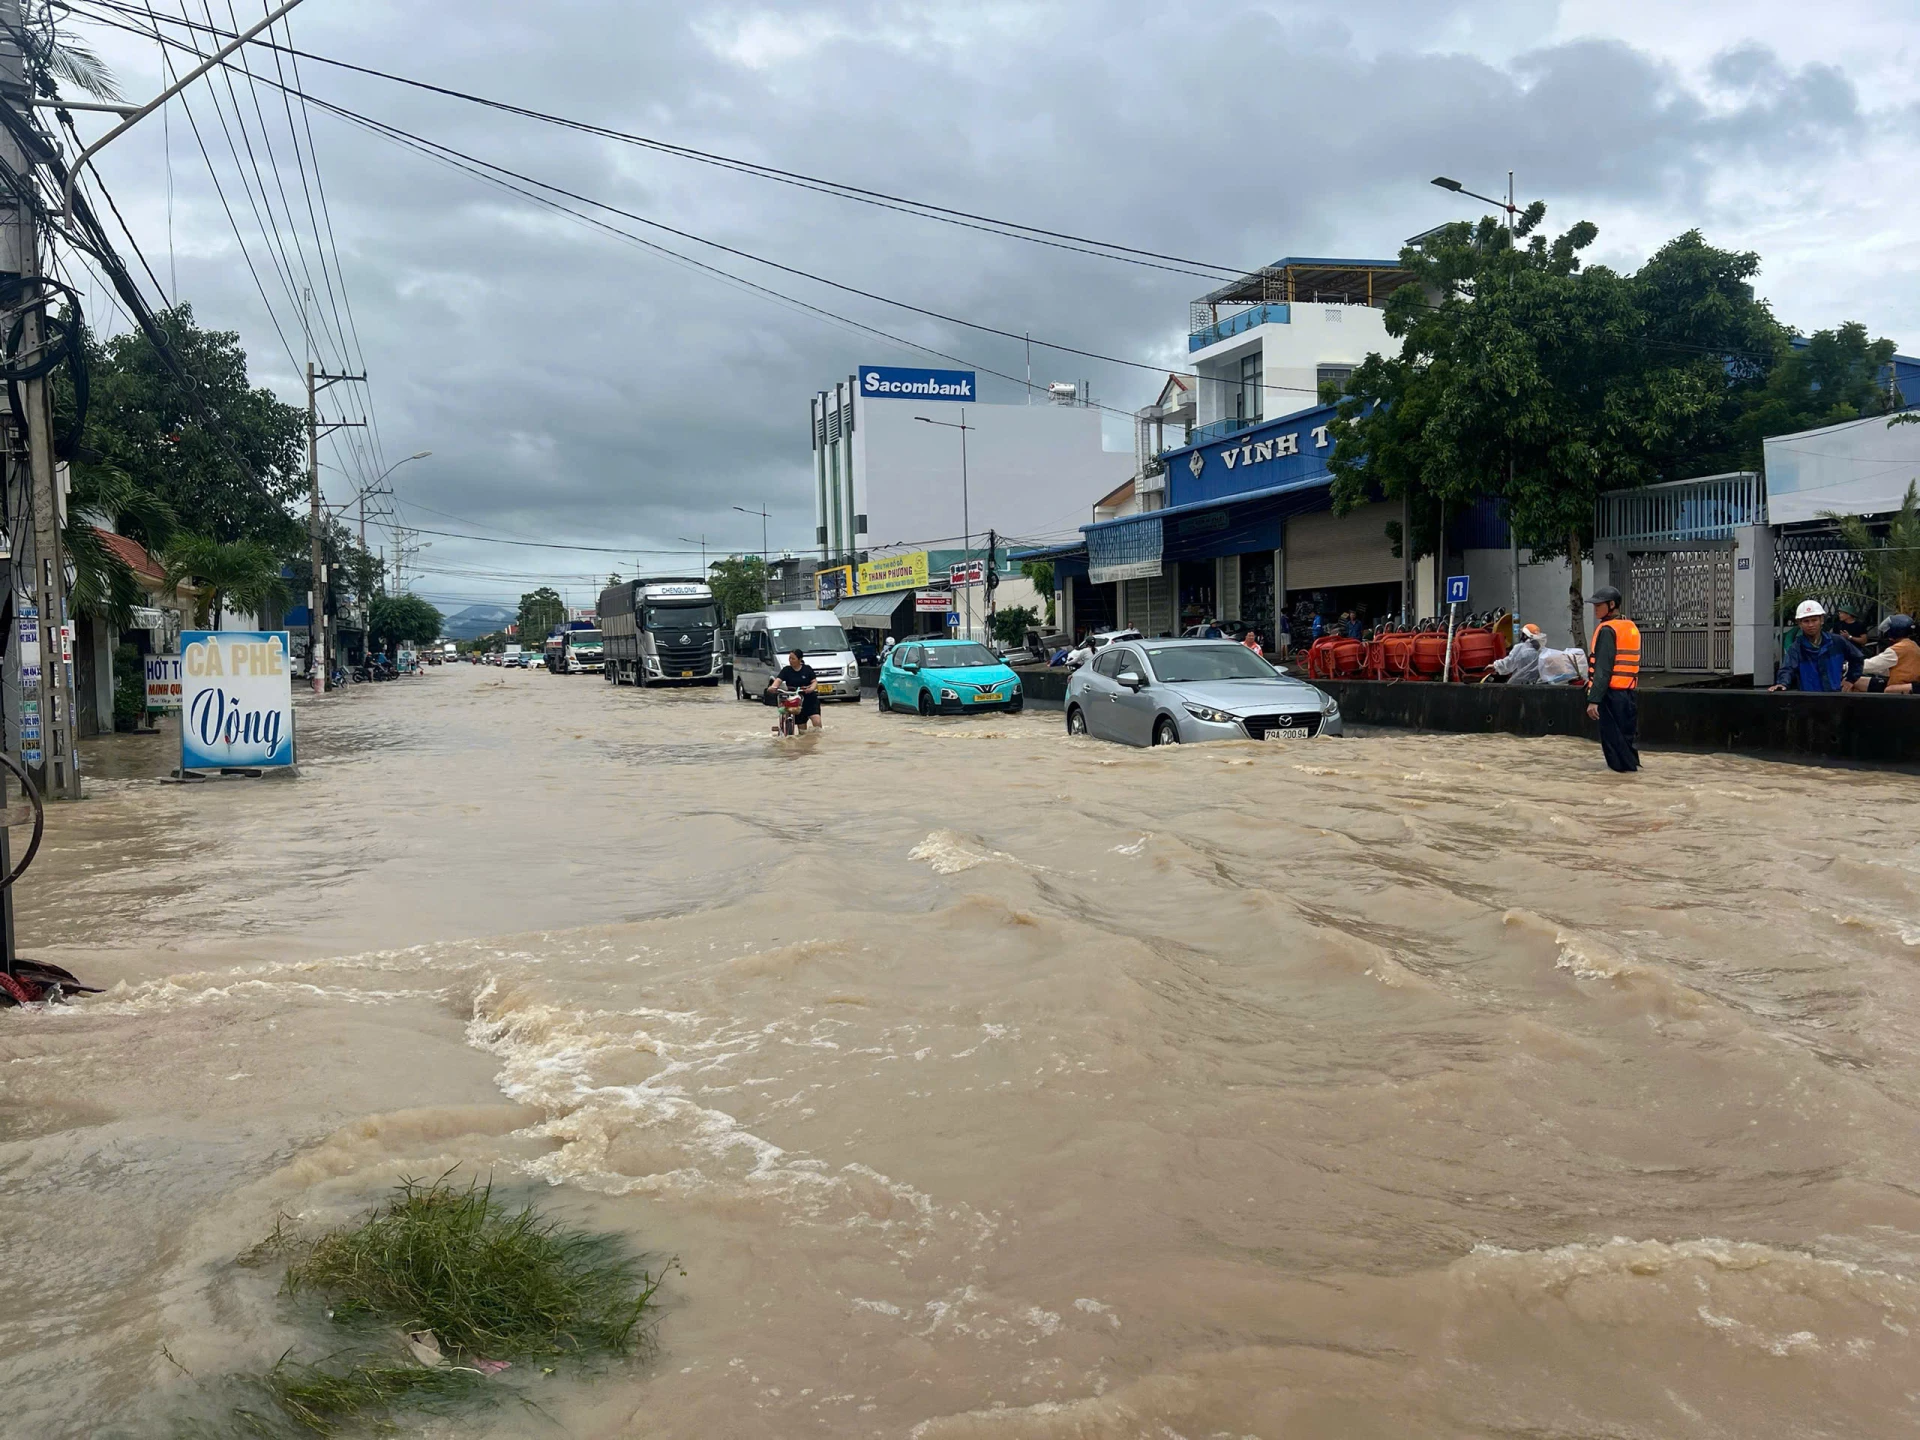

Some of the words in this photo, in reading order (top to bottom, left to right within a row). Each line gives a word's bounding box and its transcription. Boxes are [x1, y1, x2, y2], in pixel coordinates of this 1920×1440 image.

[864, 372, 972, 396] Sacombank
[1220, 432, 1299, 470] VĨNH
[868, 570, 887, 581] THANH
[888, 566, 913, 579] PHƯƠNG
[661, 586, 697, 594] CHENGLONG
[146, 655, 168, 680] HỚT
[186, 636, 223, 677] CÀ
[230, 636, 283, 677] PHÊ
[148, 683, 169, 696] MINH
[190, 687, 284, 758] Võng
